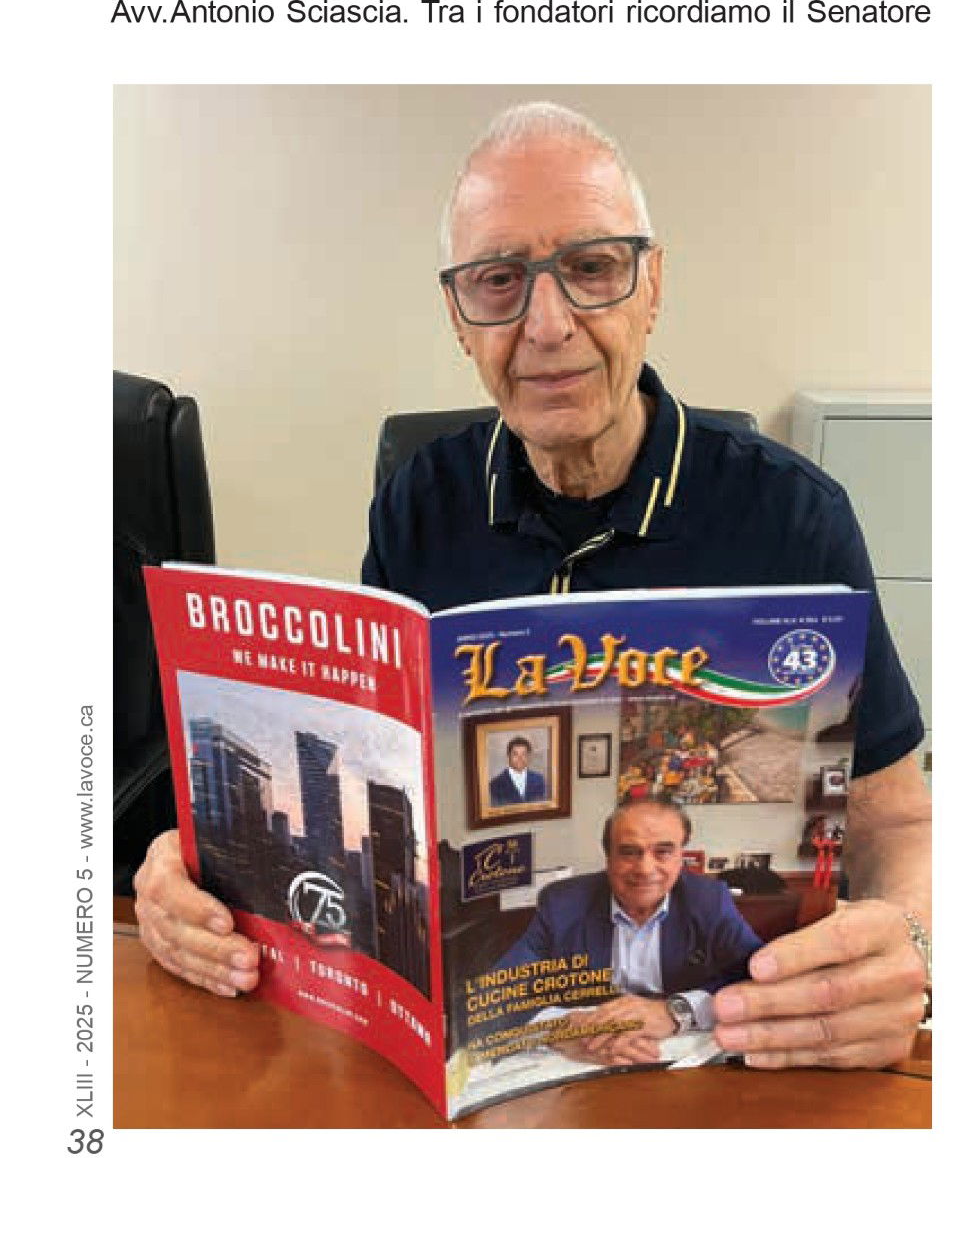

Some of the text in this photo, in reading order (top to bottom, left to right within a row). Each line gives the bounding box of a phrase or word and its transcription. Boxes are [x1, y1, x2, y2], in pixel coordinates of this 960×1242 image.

[186, 592, 402, 670] BROCCOLINI
[232, 648, 377, 693] WE MAKE IT HAPPEN
[454, 632, 711, 707] La Voce
[781, 649, 819, 673] 43
[76, 705, 94, 1118] XLIII 2025 NUMERO 5 www.lavoce.ca
[571, 953, 588, 970] DI
[467, 967, 614, 1012] CUCINE CROTONE
[67, 1128, 105, 1155] 38
